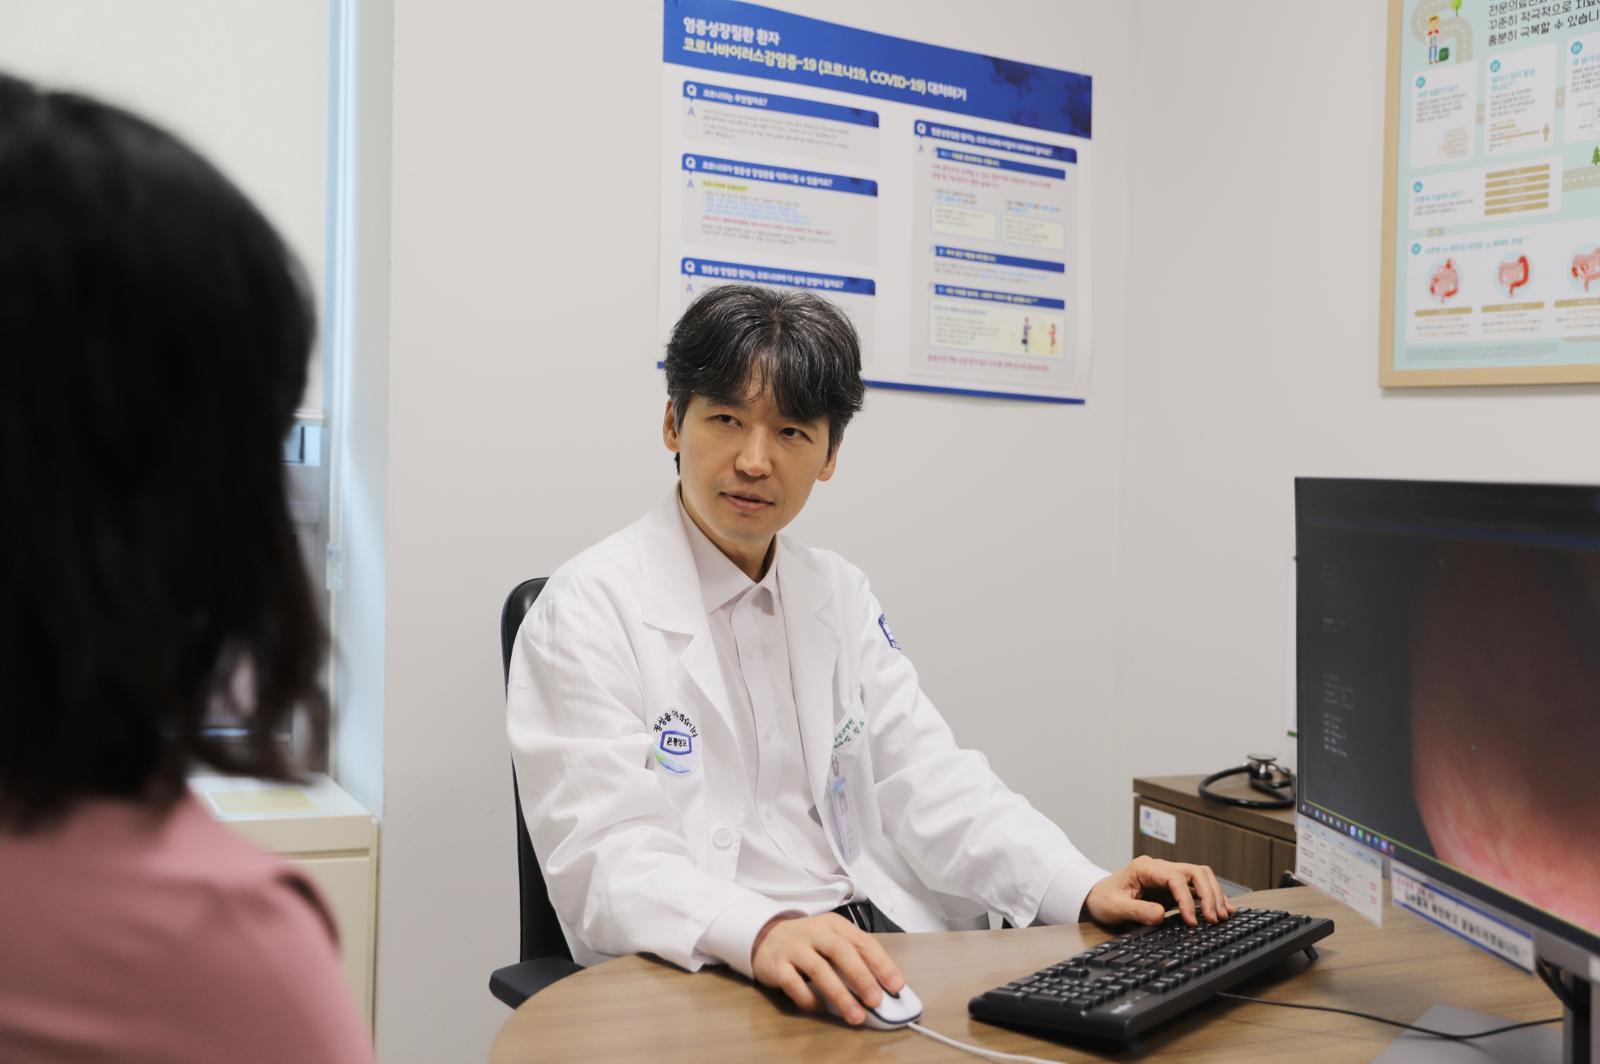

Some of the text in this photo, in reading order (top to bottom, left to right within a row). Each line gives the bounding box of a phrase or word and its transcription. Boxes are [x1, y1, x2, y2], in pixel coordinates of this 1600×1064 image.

[1489, 14, 1517, 29] 꾸준히
[1521, 1, 1571, 21] 적극적으로
[756, 28, 780, 46] 환자
[1488, 29, 1516, 46] 충분히
[1520, 22, 1550, 37] 극복할
[1554, 18, 1564, 30] 수
[686, 84, 697, 97] Q
[870, 70, 926, 95] COVID-19)
[685, 157, 696, 169] Q
[685, 261, 695, 272] Q
